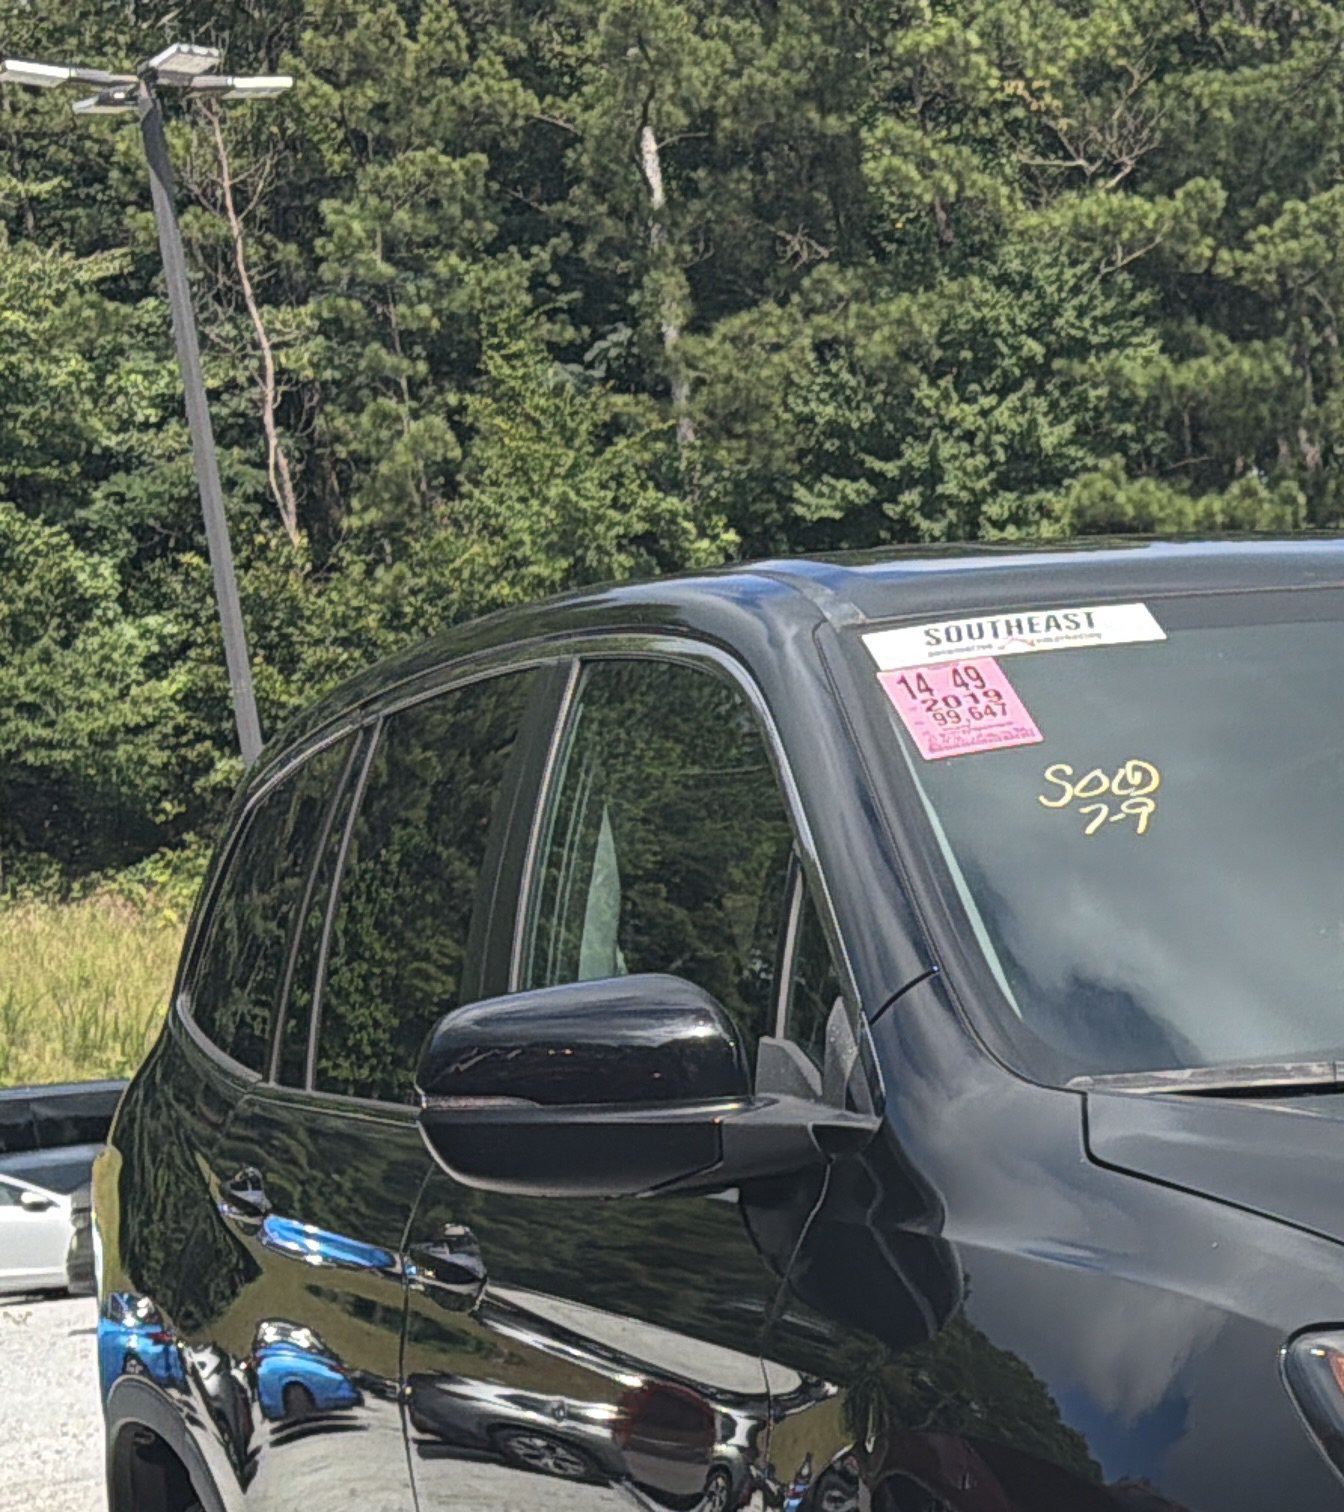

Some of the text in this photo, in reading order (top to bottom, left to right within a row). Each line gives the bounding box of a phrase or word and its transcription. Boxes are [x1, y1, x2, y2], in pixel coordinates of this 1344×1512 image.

[924, 611, 1096, 646] SOUTHEAST
[897, 666, 986, 700] 14 49
[921, 689, 1003, 712] 2019
